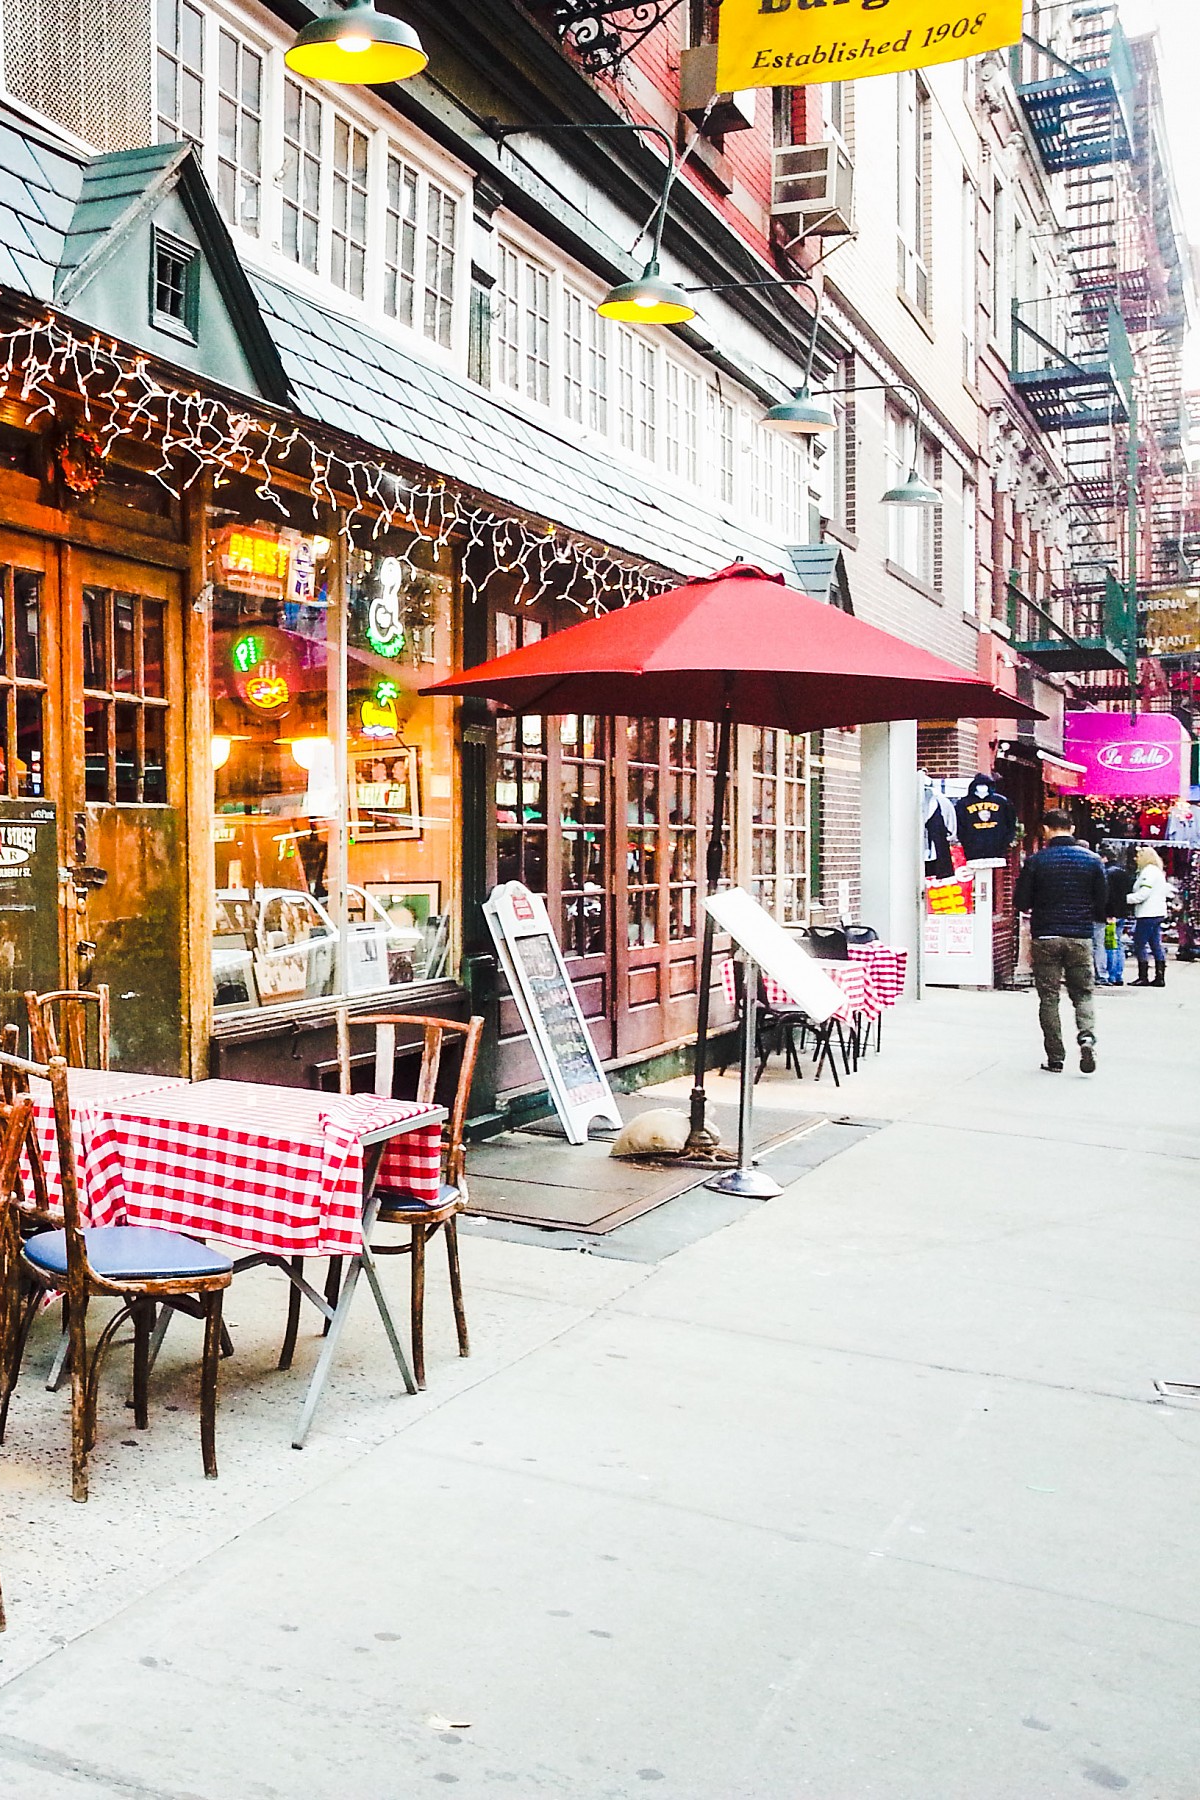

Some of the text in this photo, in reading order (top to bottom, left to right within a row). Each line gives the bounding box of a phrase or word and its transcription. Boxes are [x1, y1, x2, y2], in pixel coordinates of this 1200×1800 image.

[751, 12, 987, 69] Established 1908
[1137, 599, 1189, 612] ORIGINAL
[1104, 747, 1164, 765] La Bella
[966, 802, 1000, 814] NYPD
[6, 826, 36, 853] STREET
